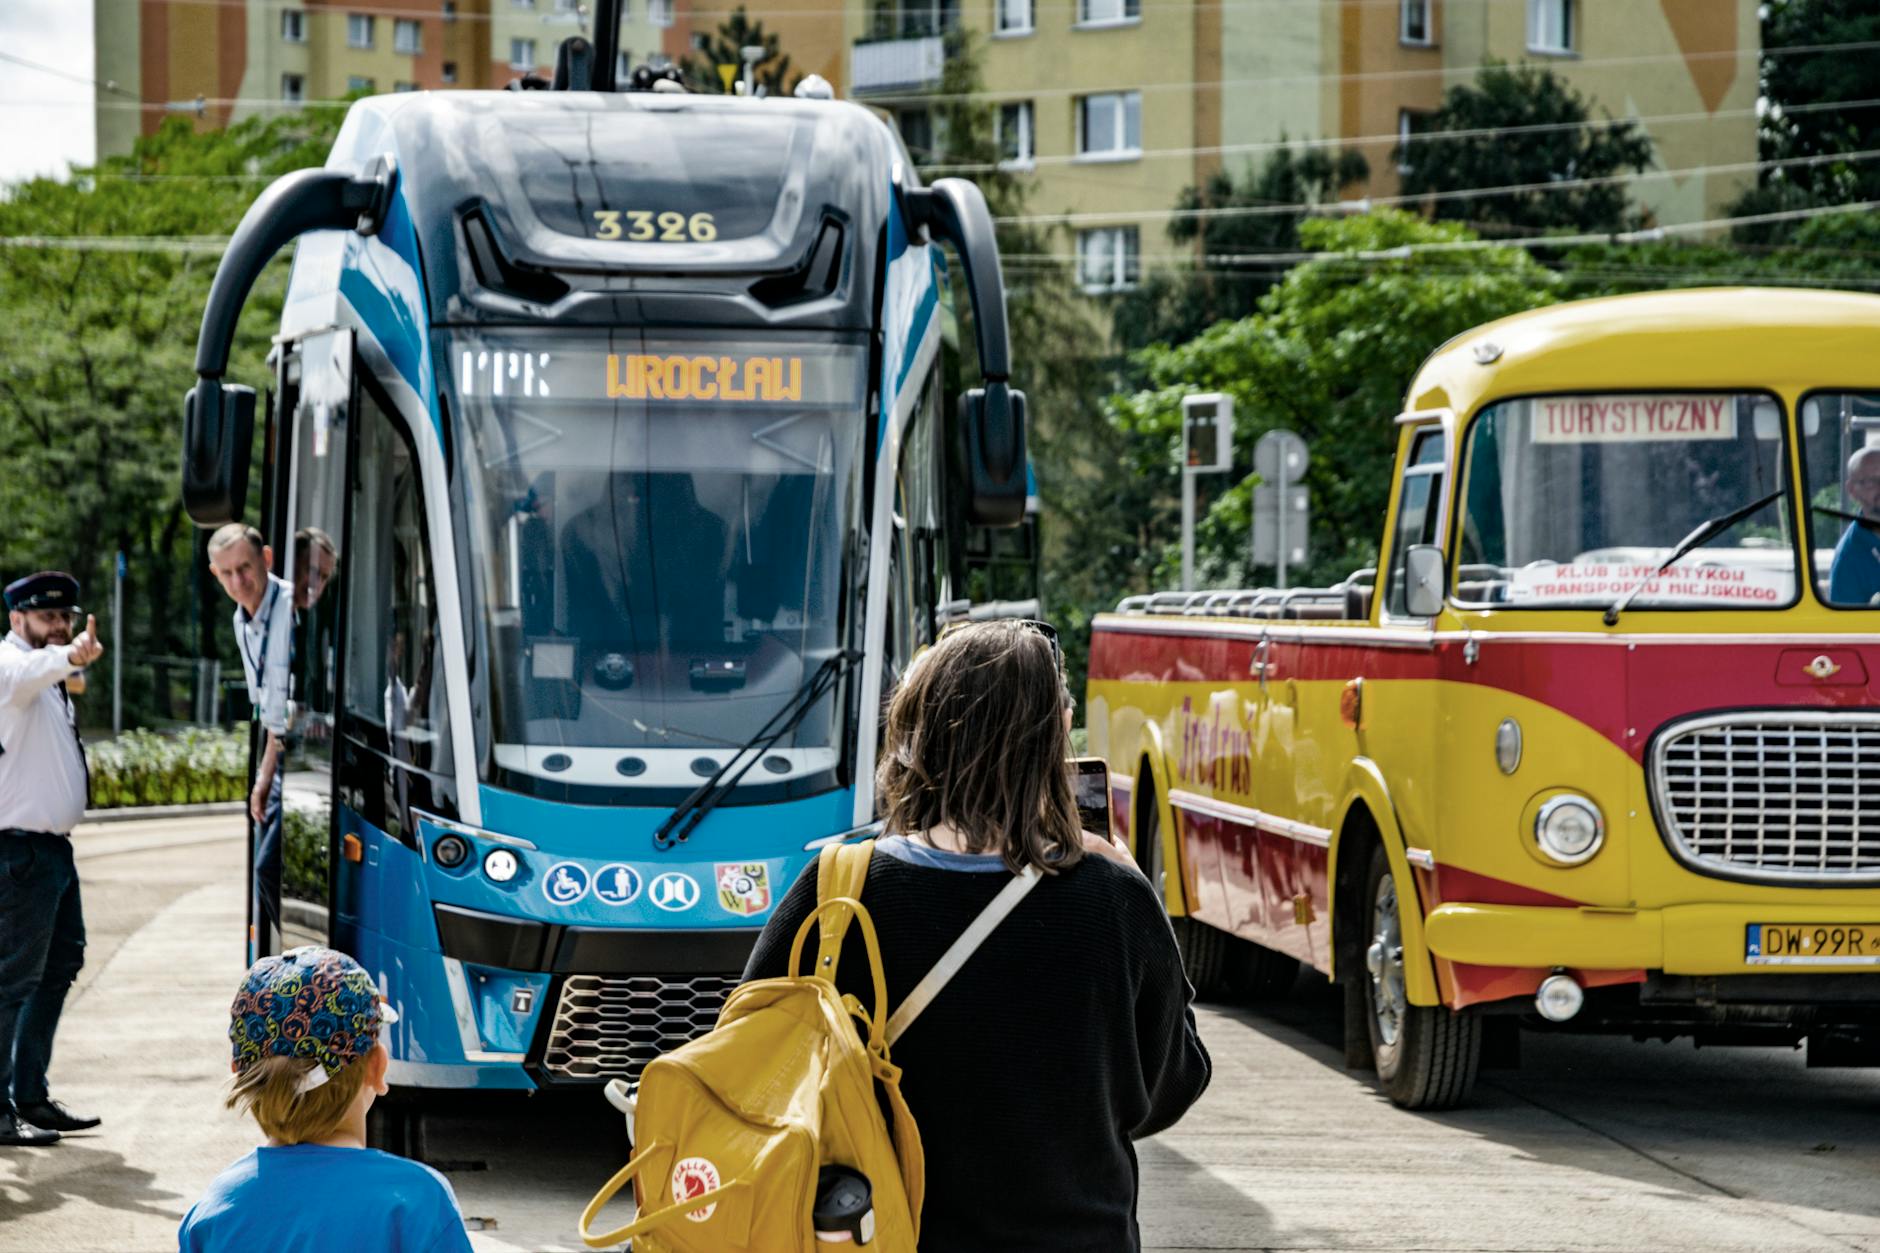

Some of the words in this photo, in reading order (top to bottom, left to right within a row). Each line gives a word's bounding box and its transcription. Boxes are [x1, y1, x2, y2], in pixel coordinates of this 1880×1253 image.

[594, 211, 717, 242] 3326
[606, 354, 801, 401] WROCŁAW
[1545, 399, 1726, 435] TURYSTYCZNY
[1556, 565, 1608, 579] KLUB
[1532, 582, 1659, 597] TRANSPORU
[1669, 582, 1777, 601] MIEJSKIEGO
[1767, 928, 1802, 955] DW
[1813, 928, 1864, 955] 99R
